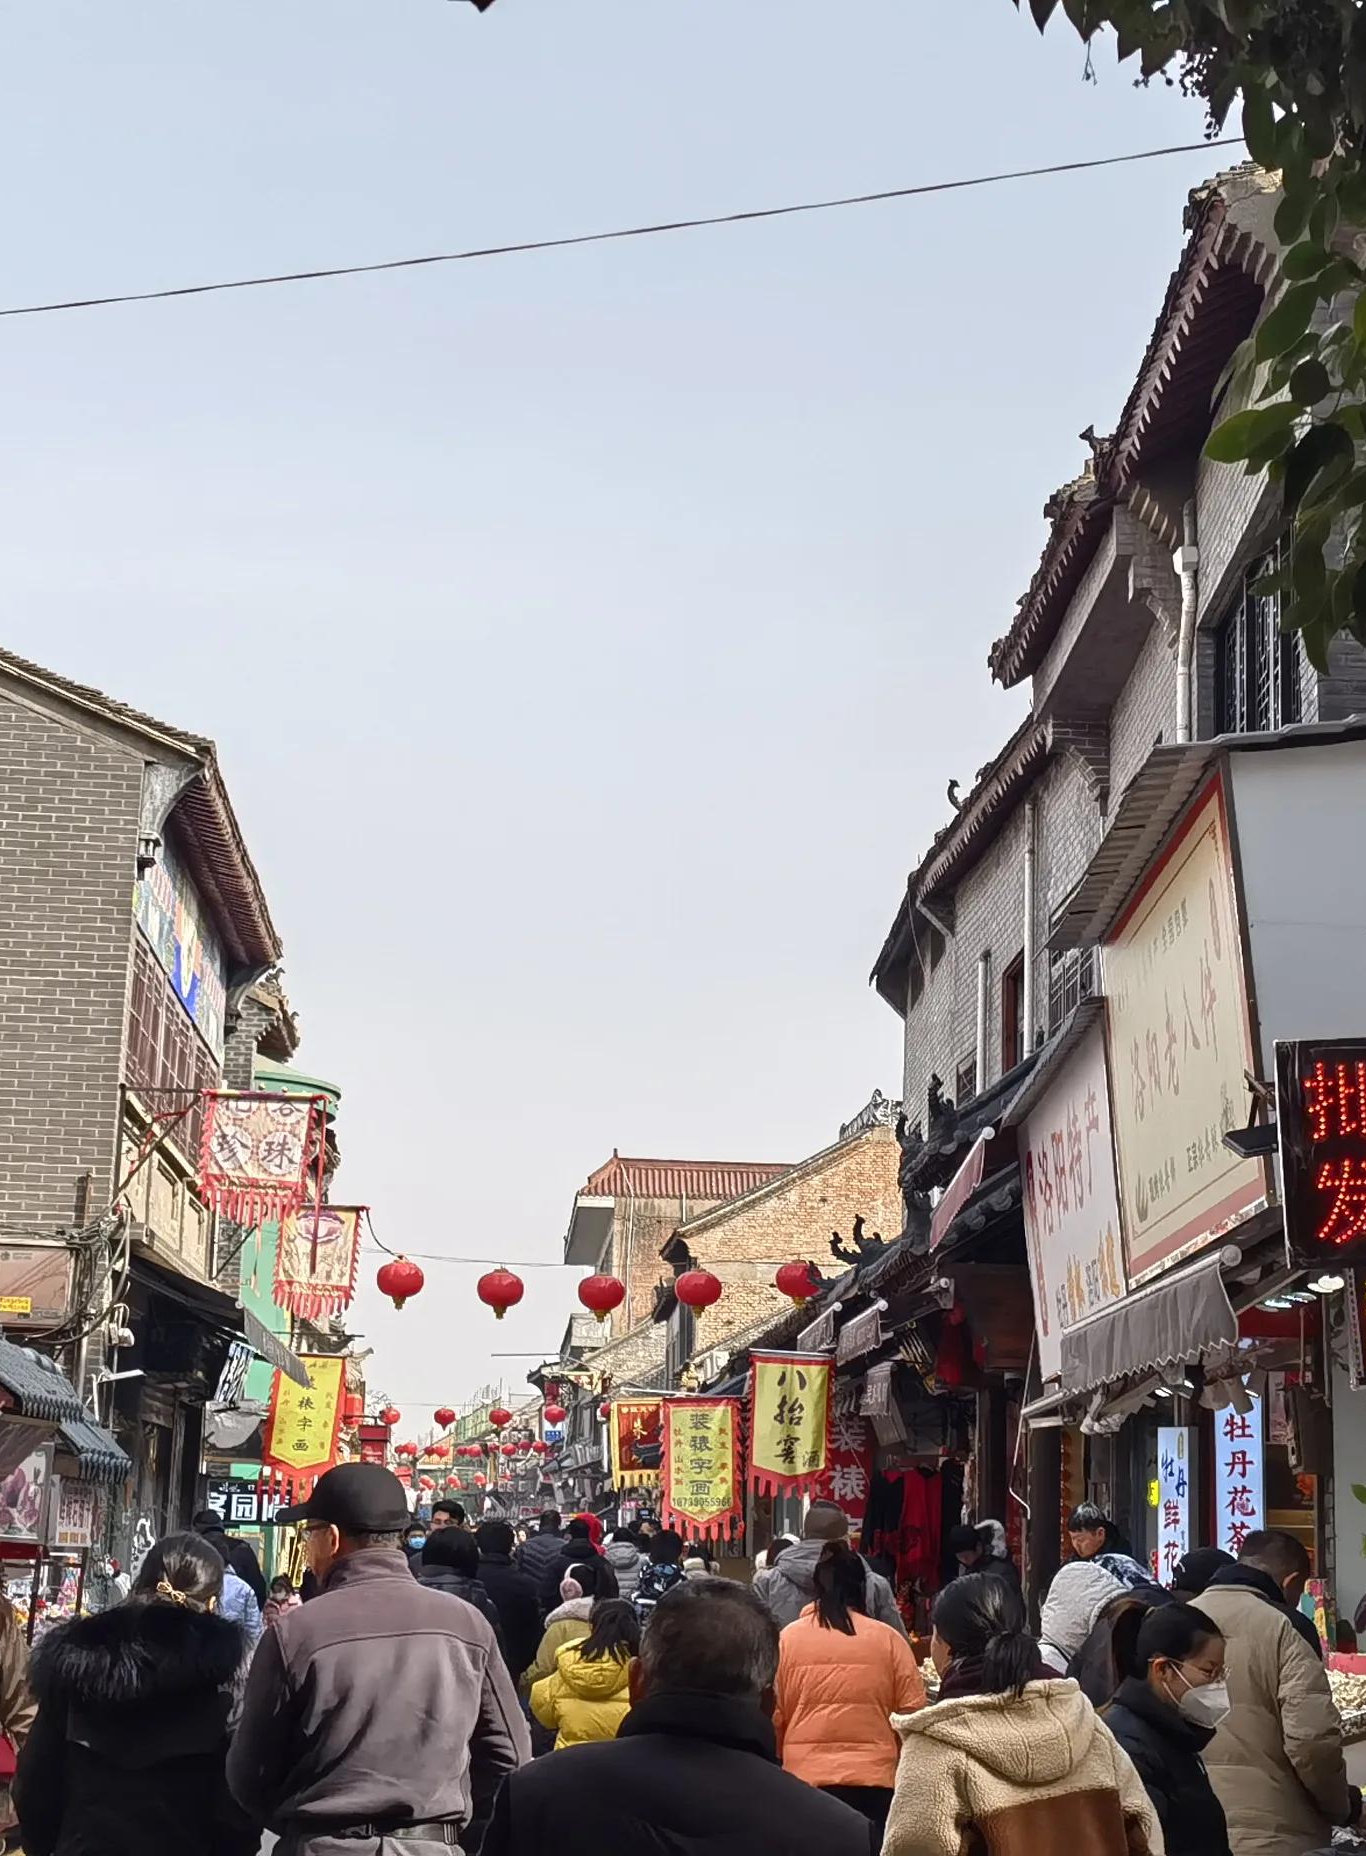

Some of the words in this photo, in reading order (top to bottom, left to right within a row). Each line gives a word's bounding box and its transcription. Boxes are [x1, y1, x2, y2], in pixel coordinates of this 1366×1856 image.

[689, 1412, 713, 1496] 装裱字画
[1161, 1449, 1187, 1591] 牡丹鲜花
[1223, 1413, 1256, 1552] 牡丹花茶
